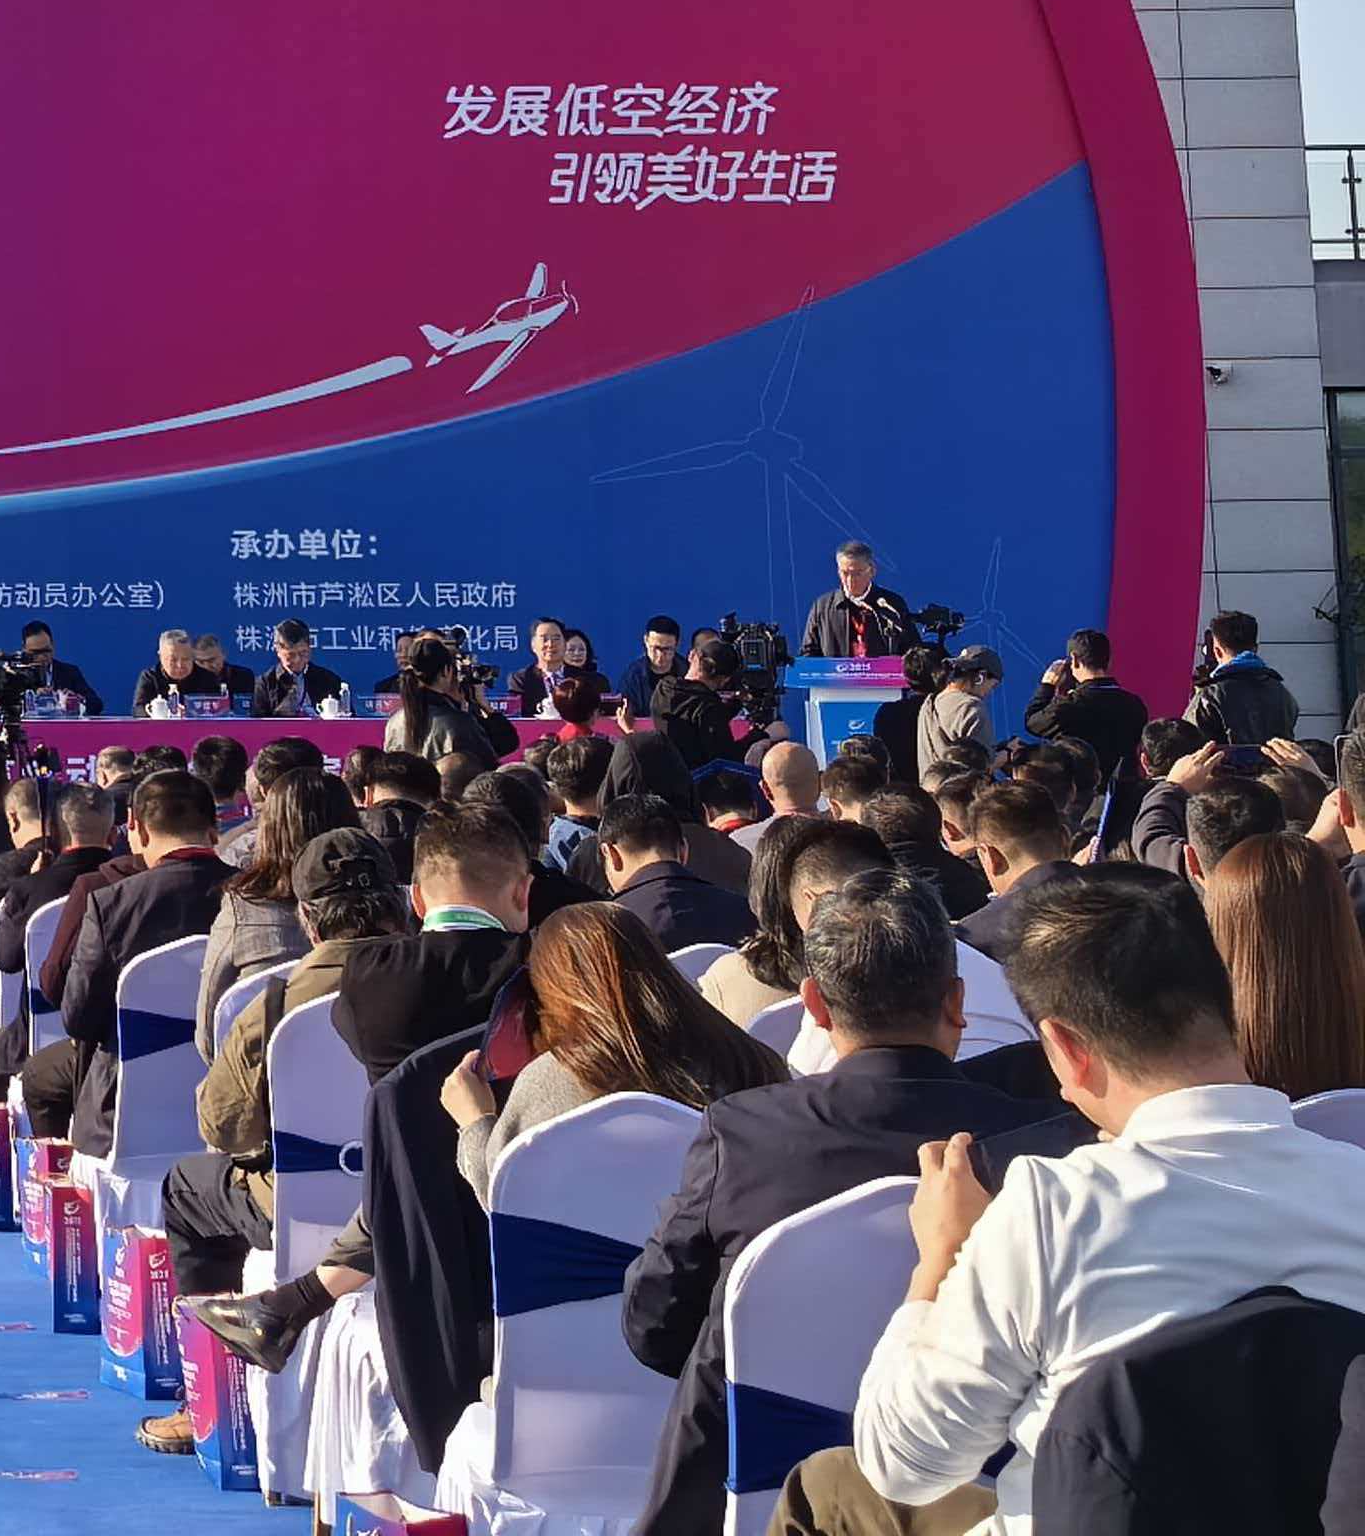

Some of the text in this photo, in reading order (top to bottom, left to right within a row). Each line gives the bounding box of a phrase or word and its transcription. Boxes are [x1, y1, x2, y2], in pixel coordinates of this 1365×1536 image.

[443, 81, 779, 139] 发展低空经济
[548, 144, 838, 211] 引领美好生活
[230, 528, 378, 560] 承办单位：
[233, 581, 518, 609] 株洲市芦淞区人民政府
